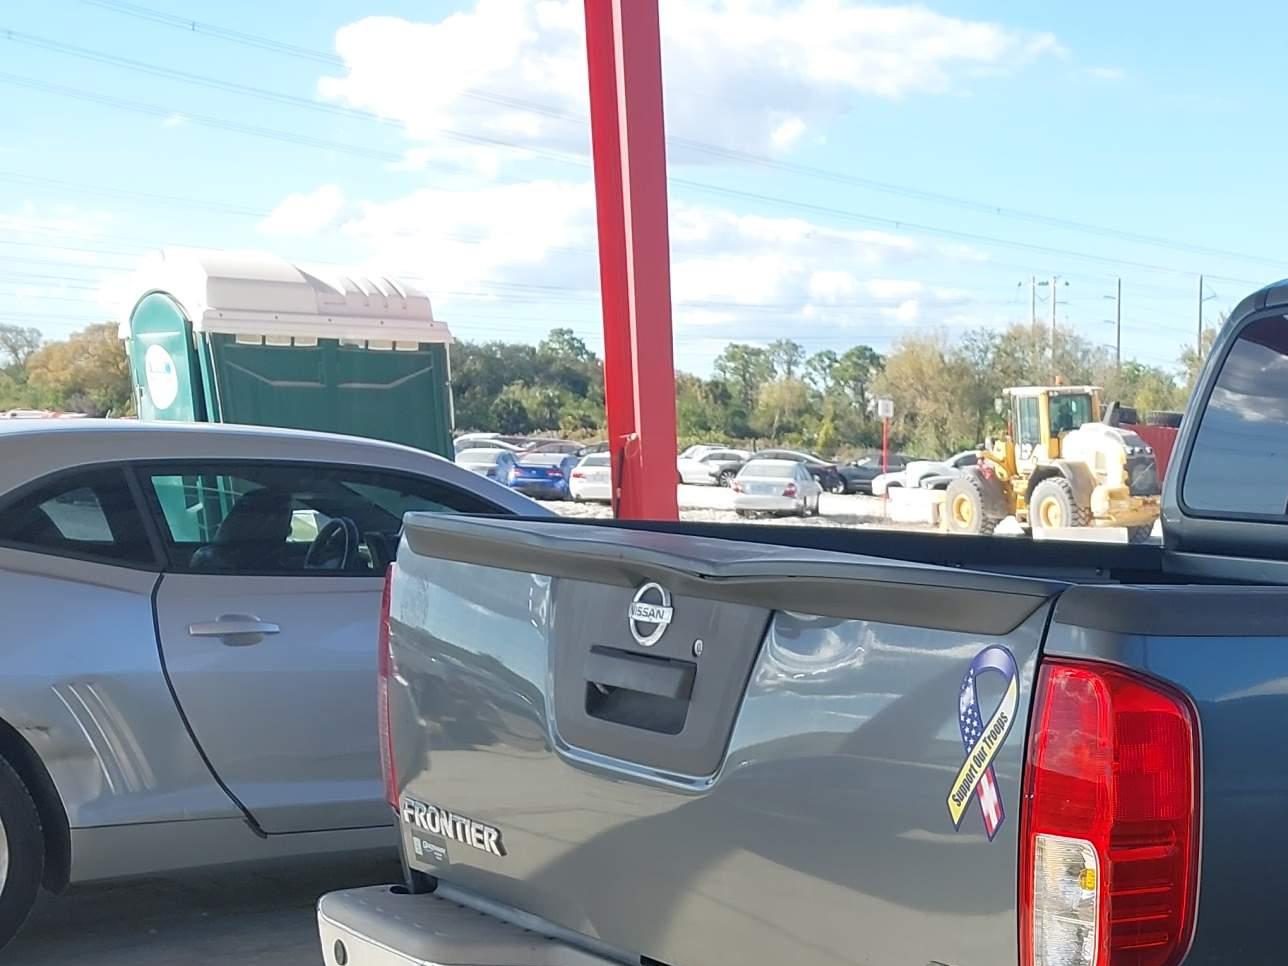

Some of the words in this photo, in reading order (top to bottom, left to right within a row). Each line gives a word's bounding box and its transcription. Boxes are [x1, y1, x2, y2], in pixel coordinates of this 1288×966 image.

[630, 604, 665, 620] NISSAN
[951, 763, 979, 808] Support
[972, 745, 989, 769] Our
[982, 710, 1009, 751] Troops
[402, 797, 507, 857] FRONTIER
